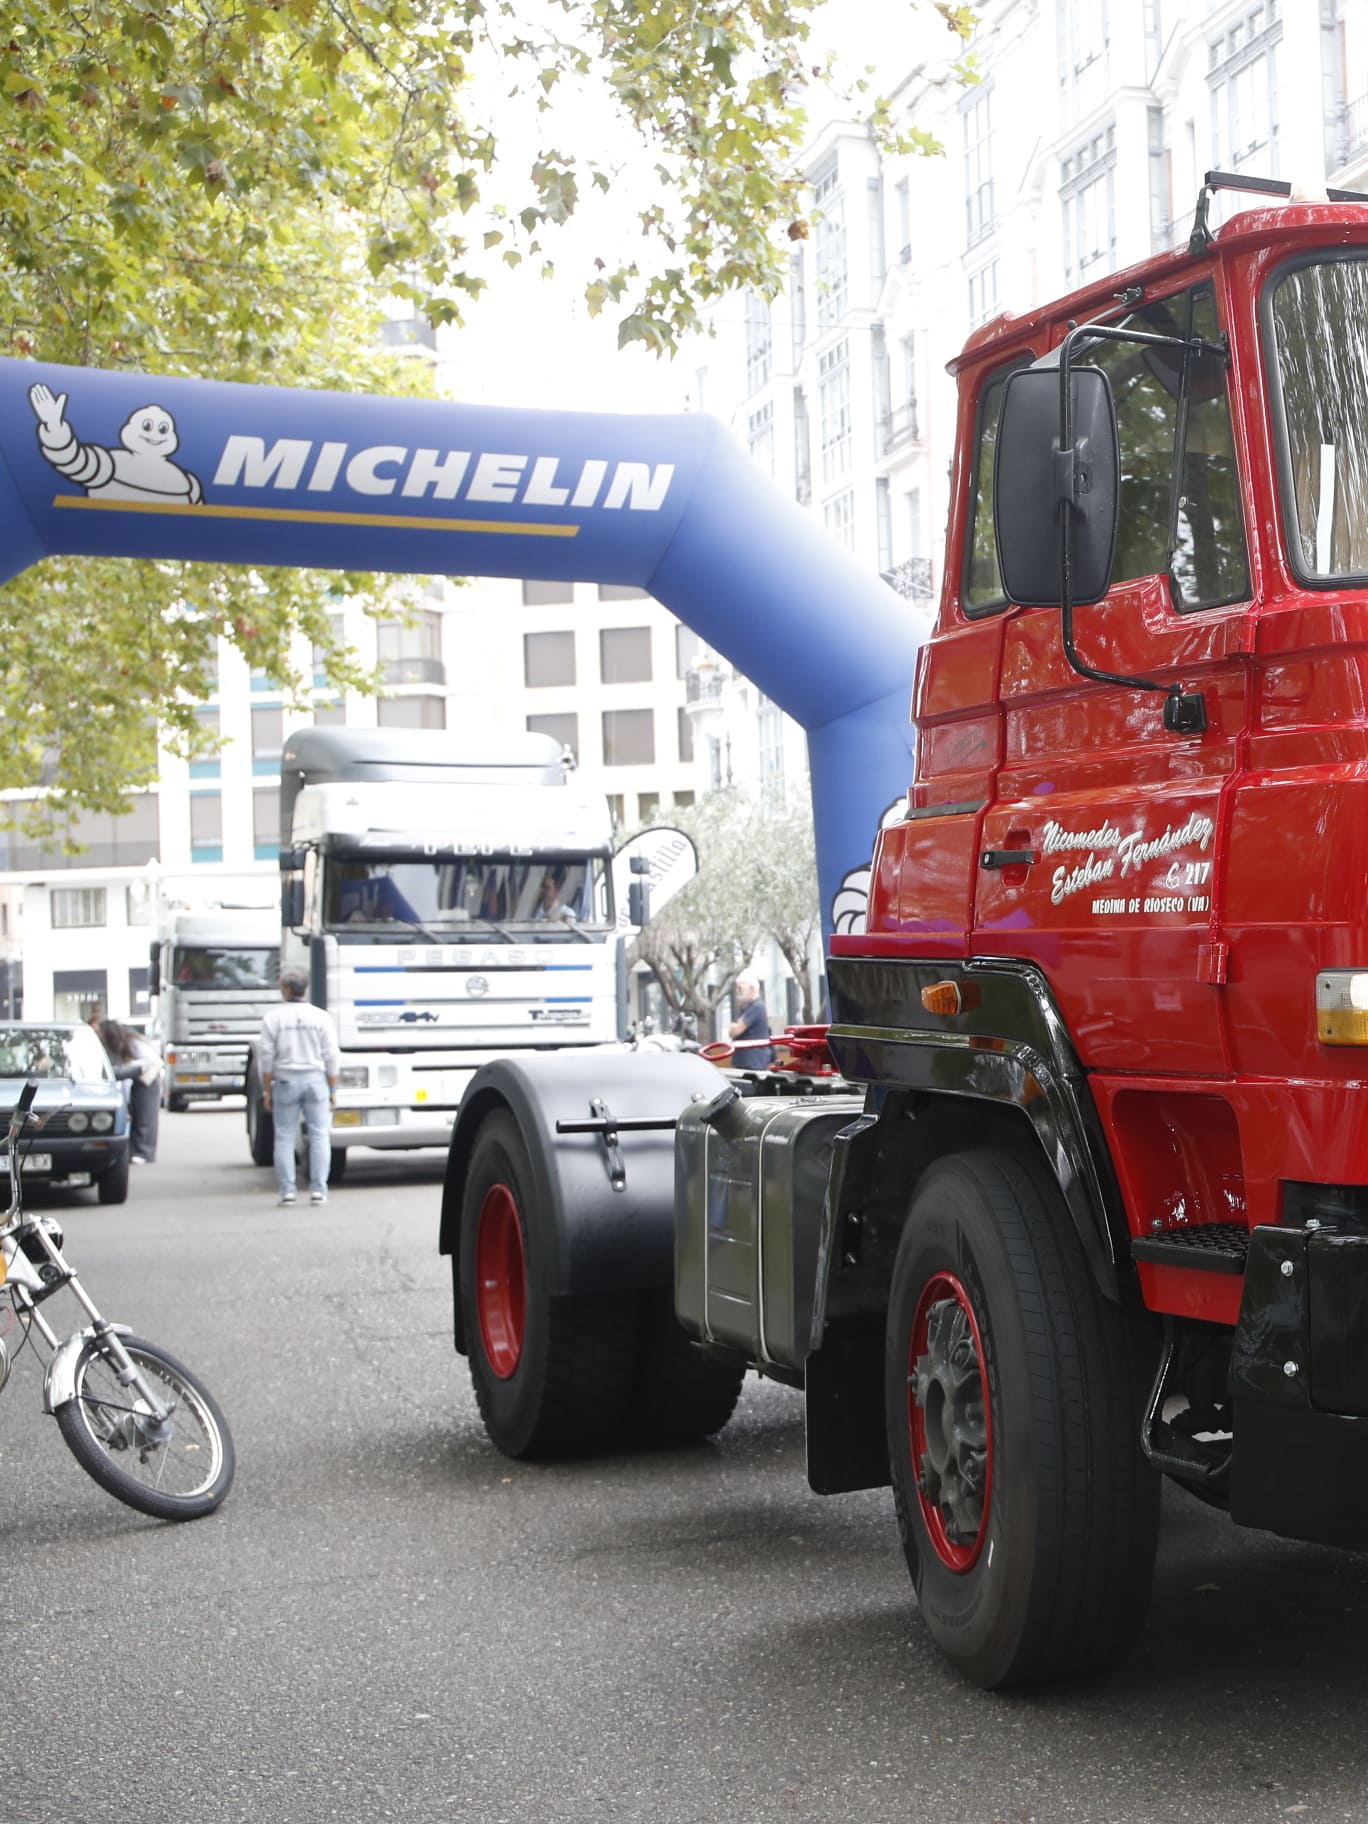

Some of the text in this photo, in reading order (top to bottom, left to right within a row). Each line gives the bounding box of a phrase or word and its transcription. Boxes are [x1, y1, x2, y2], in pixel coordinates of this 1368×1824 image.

[213, 435, 675, 511] MICHELIN
[1042, 819, 1122, 854] Nicomedes
[1050, 812, 1213, 905] Esteban Fernández
[1185, 862, 1210, 885] 217
[1092, 896, 1209, 914] MEDINA DE RIOSECO (VA)
[397, 949, 553, 965] PEGASO
